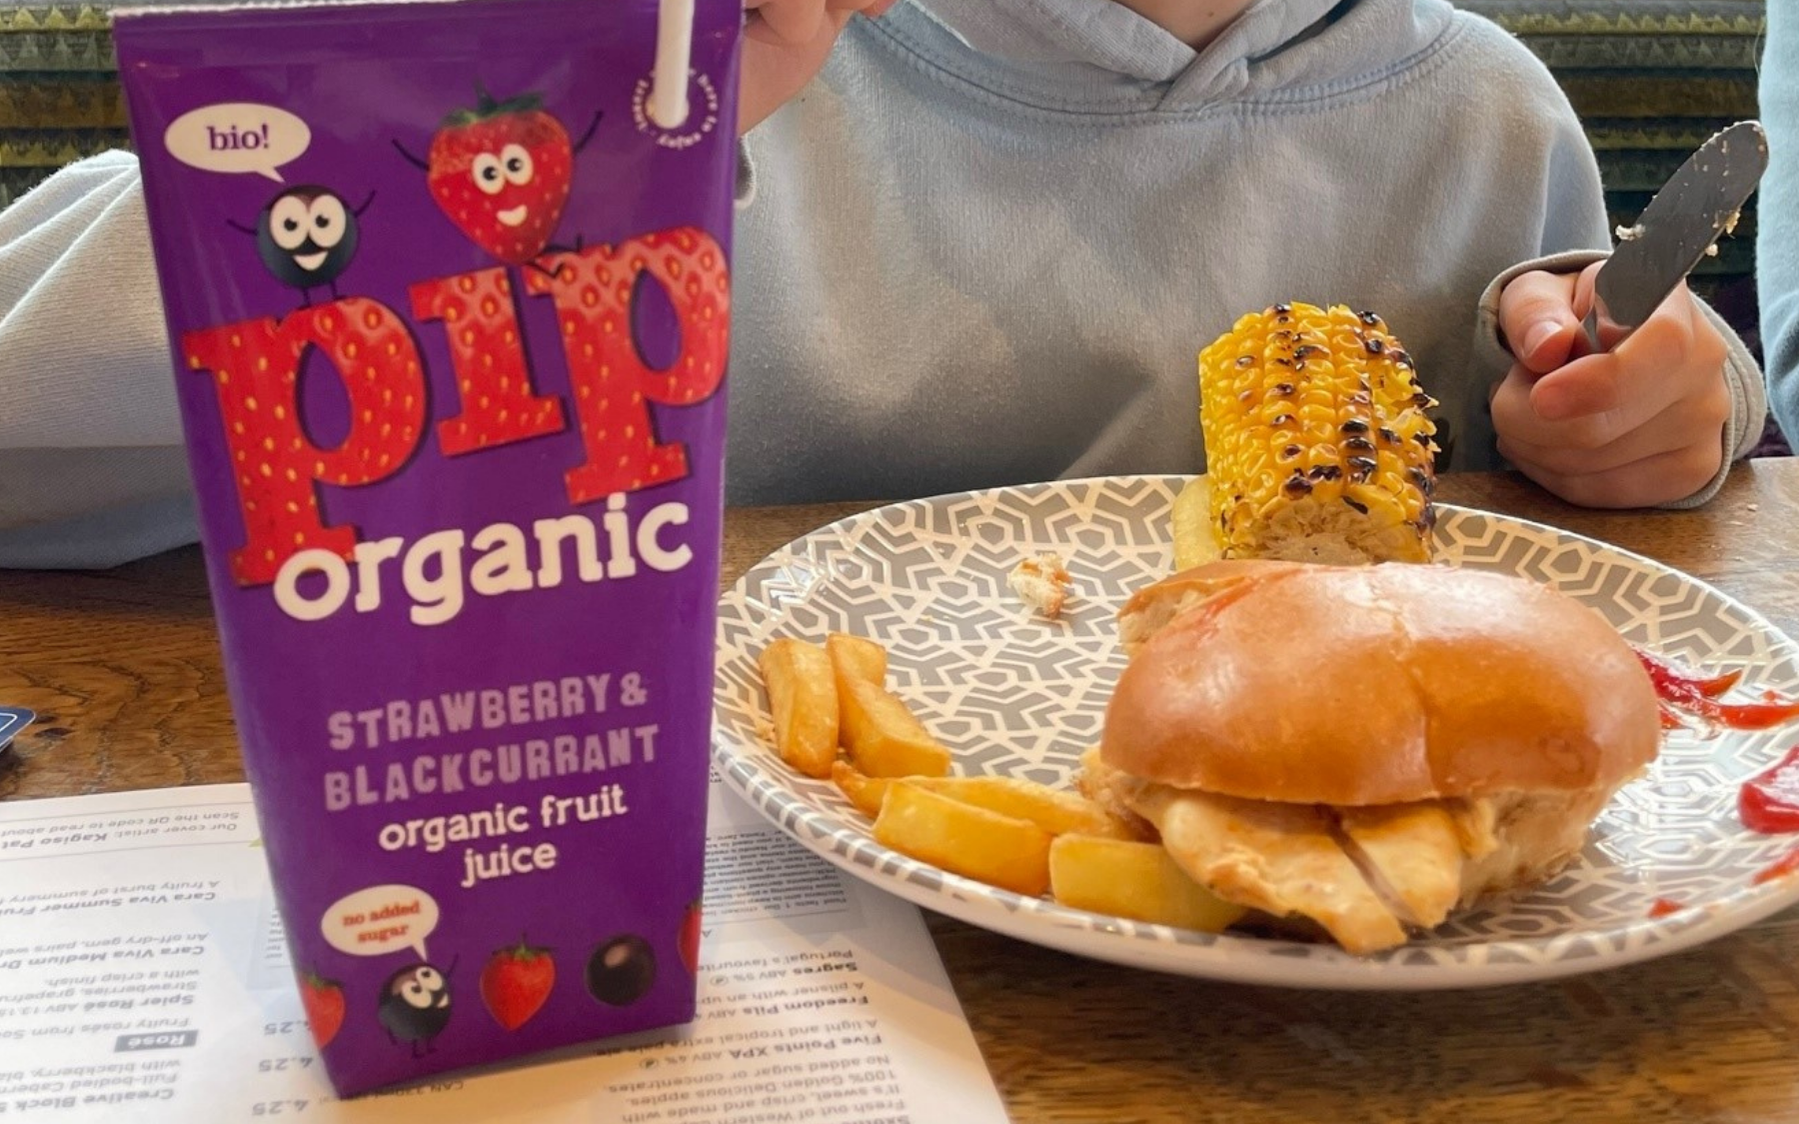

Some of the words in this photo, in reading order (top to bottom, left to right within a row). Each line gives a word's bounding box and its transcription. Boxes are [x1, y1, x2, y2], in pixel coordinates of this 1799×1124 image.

[206, 123, 268, 151] bio!
[183, 225, 731, 588] pip
[273, 492, 693, 626] organic
[327, 673, 611, 750] STRAWBERRY
[619, 671, 648, 707] &
[324, 724, 660, 812] BLACKCURRANT
[148, 816, 170, 824] QR
[174, 814, 198, 823] the
[202, 812, 240, 821] Scan
[378, 802, 530, 852] organic
[540, 783, 629, 827] fruit
[48, 824, 84, 834] read
[88, 822, 104, 830] to
[108, 818, 144, 828] code
[163, 824, 206, 834] cover
[210, 822, 238, 832] Our
[1, 828, 45, 837] about
[40, 832, 108, 846] Kagiso
[461, 840, 558, 888] juice
[113, 883, 156, 895] burst
[160, 880, 203, 891] fruity
[8, 889, 88, 904] summery
[91, 887, 109, 898] of
[174, 891, 216, 902] Cara
[128, 894, 168, 904] Viva
[40, 898, 122, 913] Summer
[343, 914, 365, 927] no
[370, 900, 420, 922] added
[126, 933, 182, 946] off-dry
[186, 932, 208, 942] An
[357, 924, 408, 943] sugar
[32, 940, 77, 953] pairs
[160, 946, 204, 956] Cara
[27, 952, 106, 968] Medium
[112, 948, 154, 960] Viva
[772, 948, 854, 966] Portugal's
[164, 968, 200, 980] with
[792, 960, 858, 976] Sagres
[100, 971, 144, 983] crisp
[146, 970, 159, 979] a
[758, 969, 787, 980] ABV
[44, 975, 97, 988] finish.
[853, 981, 864, 990] A
[752, 988, 788, 1000] with
[794, 980, 848, 997] pilsner
[82, 998, 134, 1012] Rosé
[139, 992, 194, 1007] Spier
[726, 994, 748, 1004] an
[784, 996, 869, 1012] Freedom
[44, 1002, 79, 1014] ABV
[706, 1008, 737, 1019] ABV
[742, 1004, 779, 1016] Pils
[81, 1021, 131, 1033] rosés
[136, 1017, 190, 1029] Fruity
[824, 1020, 862, 1034] light
[865, 1018, 878, 1028] A
[0, 1029, 26, 1040] So
[31, 1026, 74, 1037] from
[718, 1028, 784, 1046] tropical
[788, 1026, 819, 1038] and
[127, 1034, 186, 1048] Rosé
[841, 1034, 882, 1046] Five
[774, 1039, 836, 1054] Points
[691, 1050, 723, 1062] ABV
[728, 1046, 768, 1060] XPA
[141, 1060, 180, 1071] with
[257, 1056, 314, 1072] 4.25
[808, 1057, 861, 1072] added
[866, 1054, 890, 1066] No
[731, 1070, 748, 1080] or
[754, 1064, 804, 1078] sugar
[848, 1069, 896, 1084] 100%
[70, 1073, 177, 1090] Full-bodied
[782, 1075, 843, 1090] Golden
[694, 1082, 777, 1098] Delicious
[810, 1088, 868, 1102] sweet,
[873, 1084, 900, 1095] It's
[82, 1088, 174, 1104] Creative
[760, 1094, 806, 1106] crisp
[14, 1096, 76, 1111] Block
[250, 1100, 309, 1116] 4.25
[722, 1100, 756, 1112] and
[820, 1104, 848, 1114] out
[853, 1098, 904, 1112] Fresh
[621, 1110, 661, 1123] with
[666, 1104, 717, 1117] made
[797, 1108, 815, 1118] of
